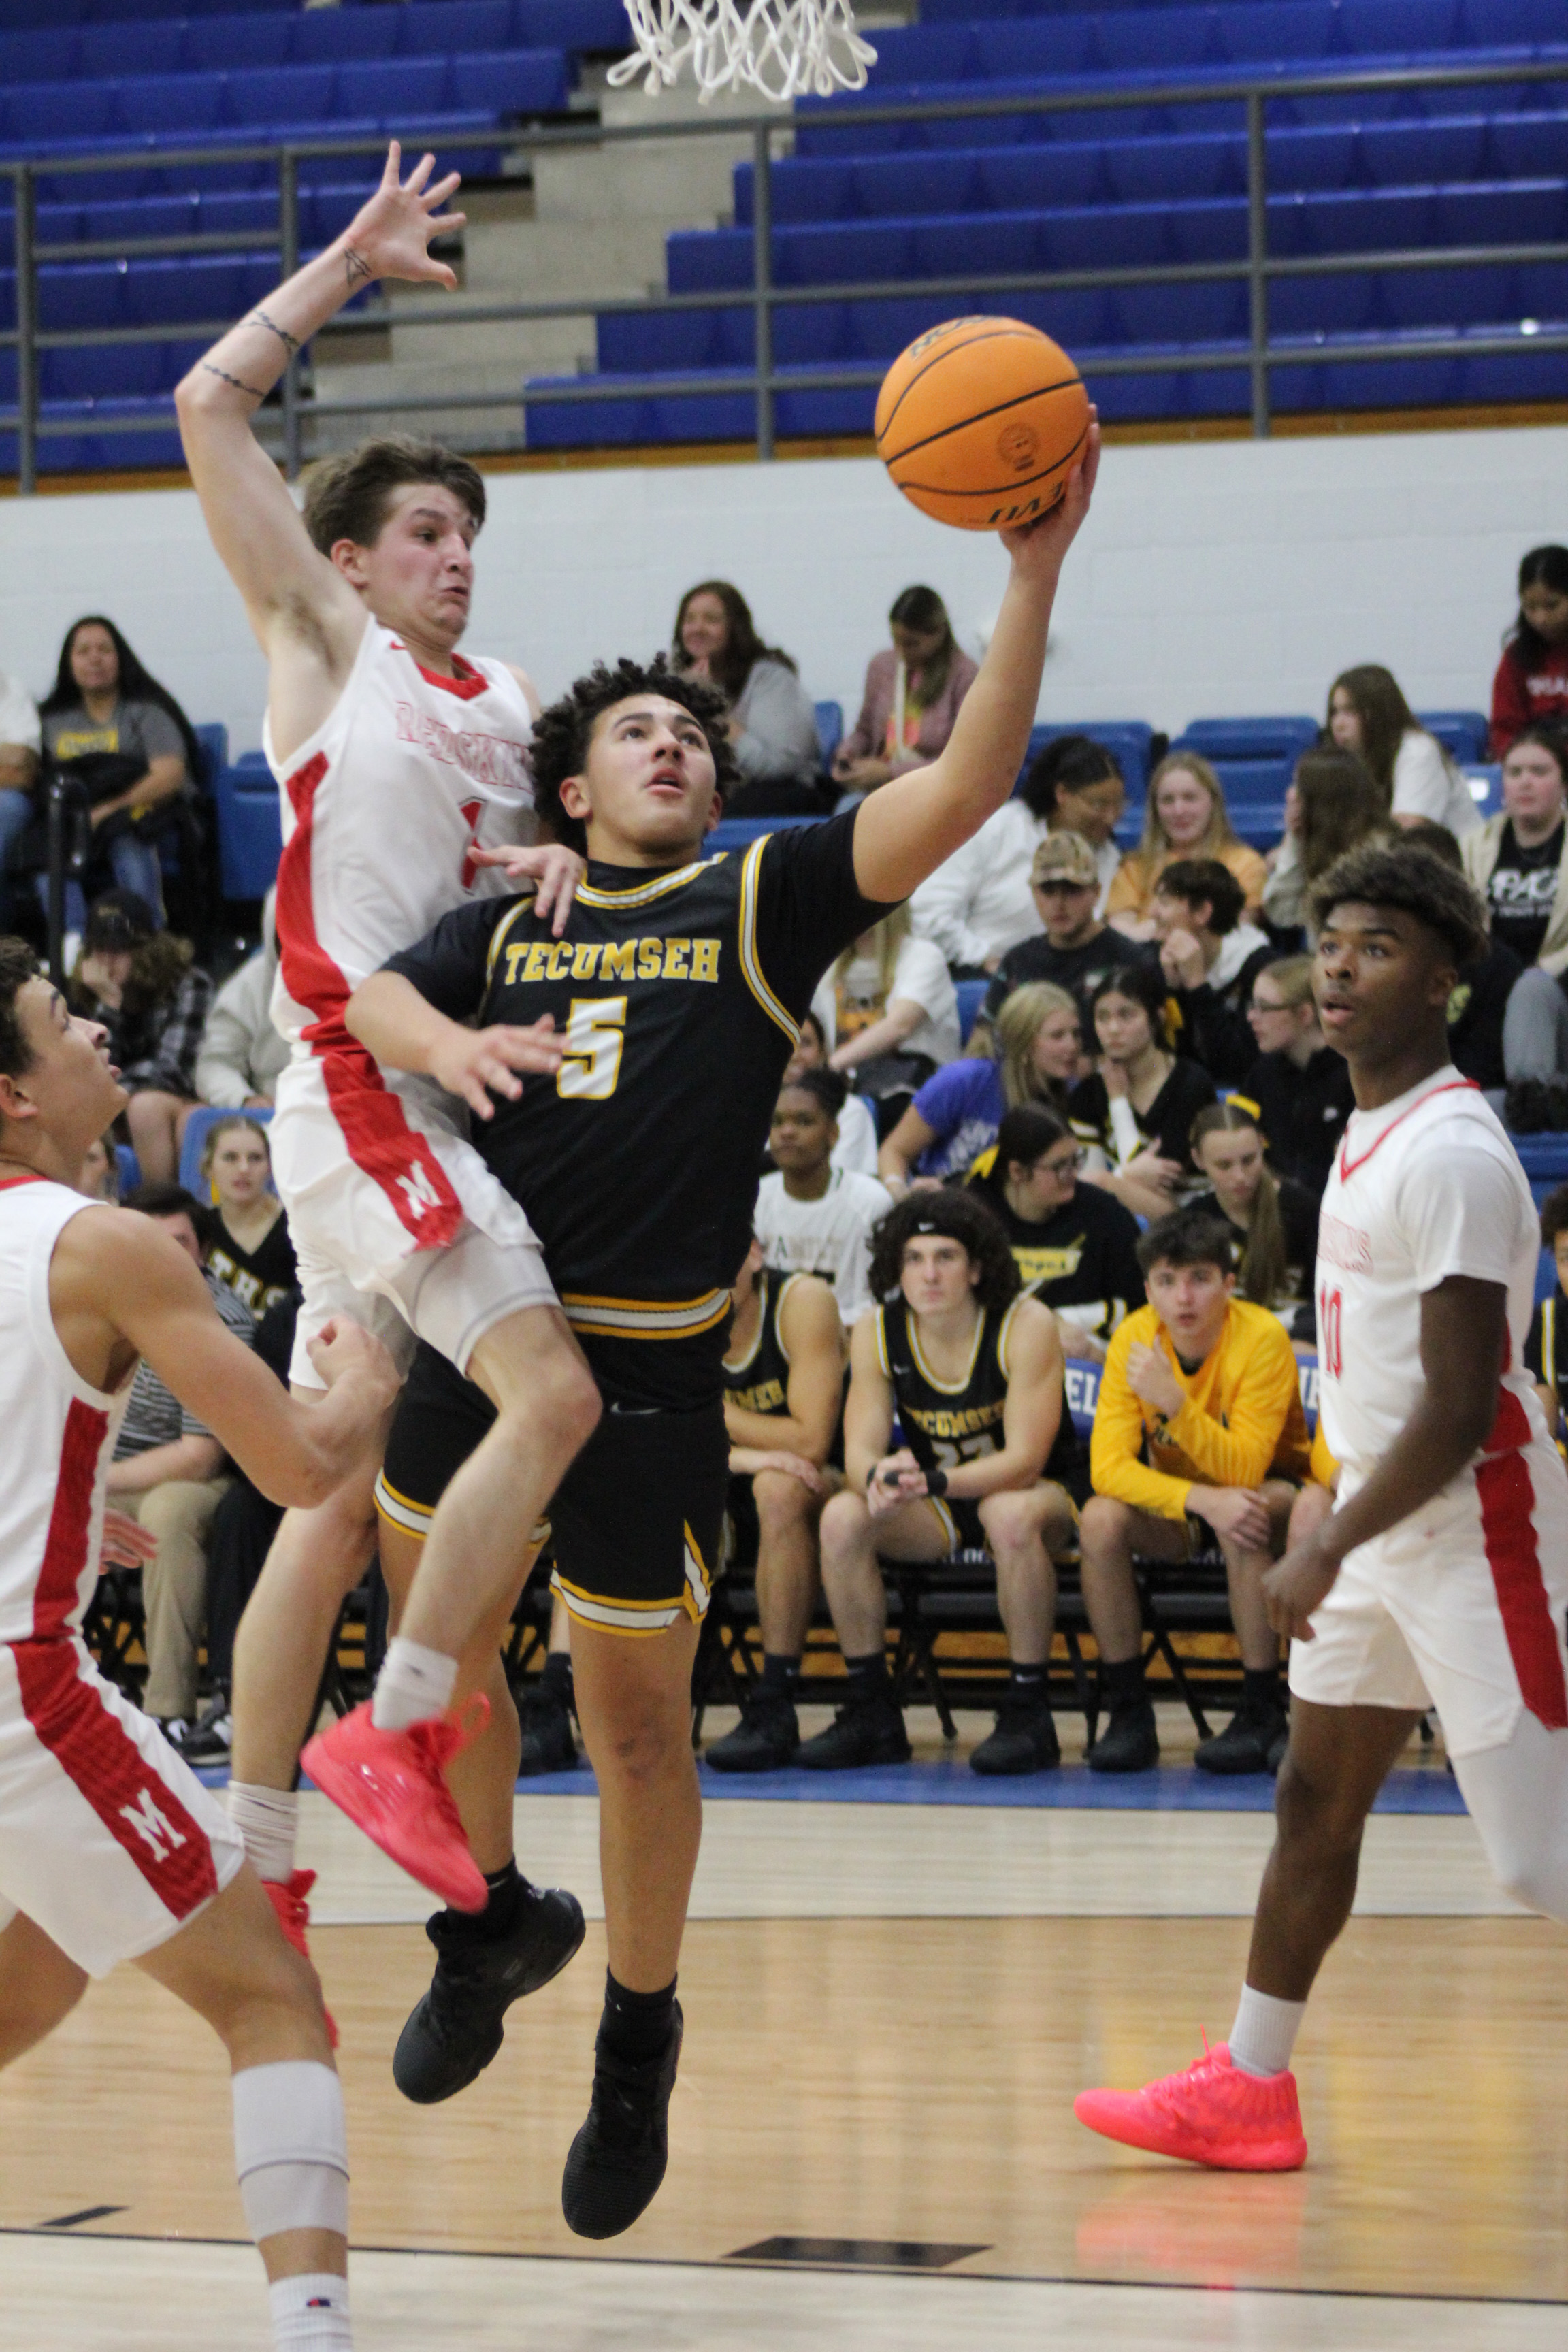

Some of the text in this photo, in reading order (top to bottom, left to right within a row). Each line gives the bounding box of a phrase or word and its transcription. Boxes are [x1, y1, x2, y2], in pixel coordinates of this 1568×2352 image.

[504, 937, 721, 985] TECUMSEH
[556, 995, 628, 1100] 5
[394, 1159, 443, 1221] M
[1320, 1279, 1344, 1385] 10
[118, 1786, 187, 1863] M
